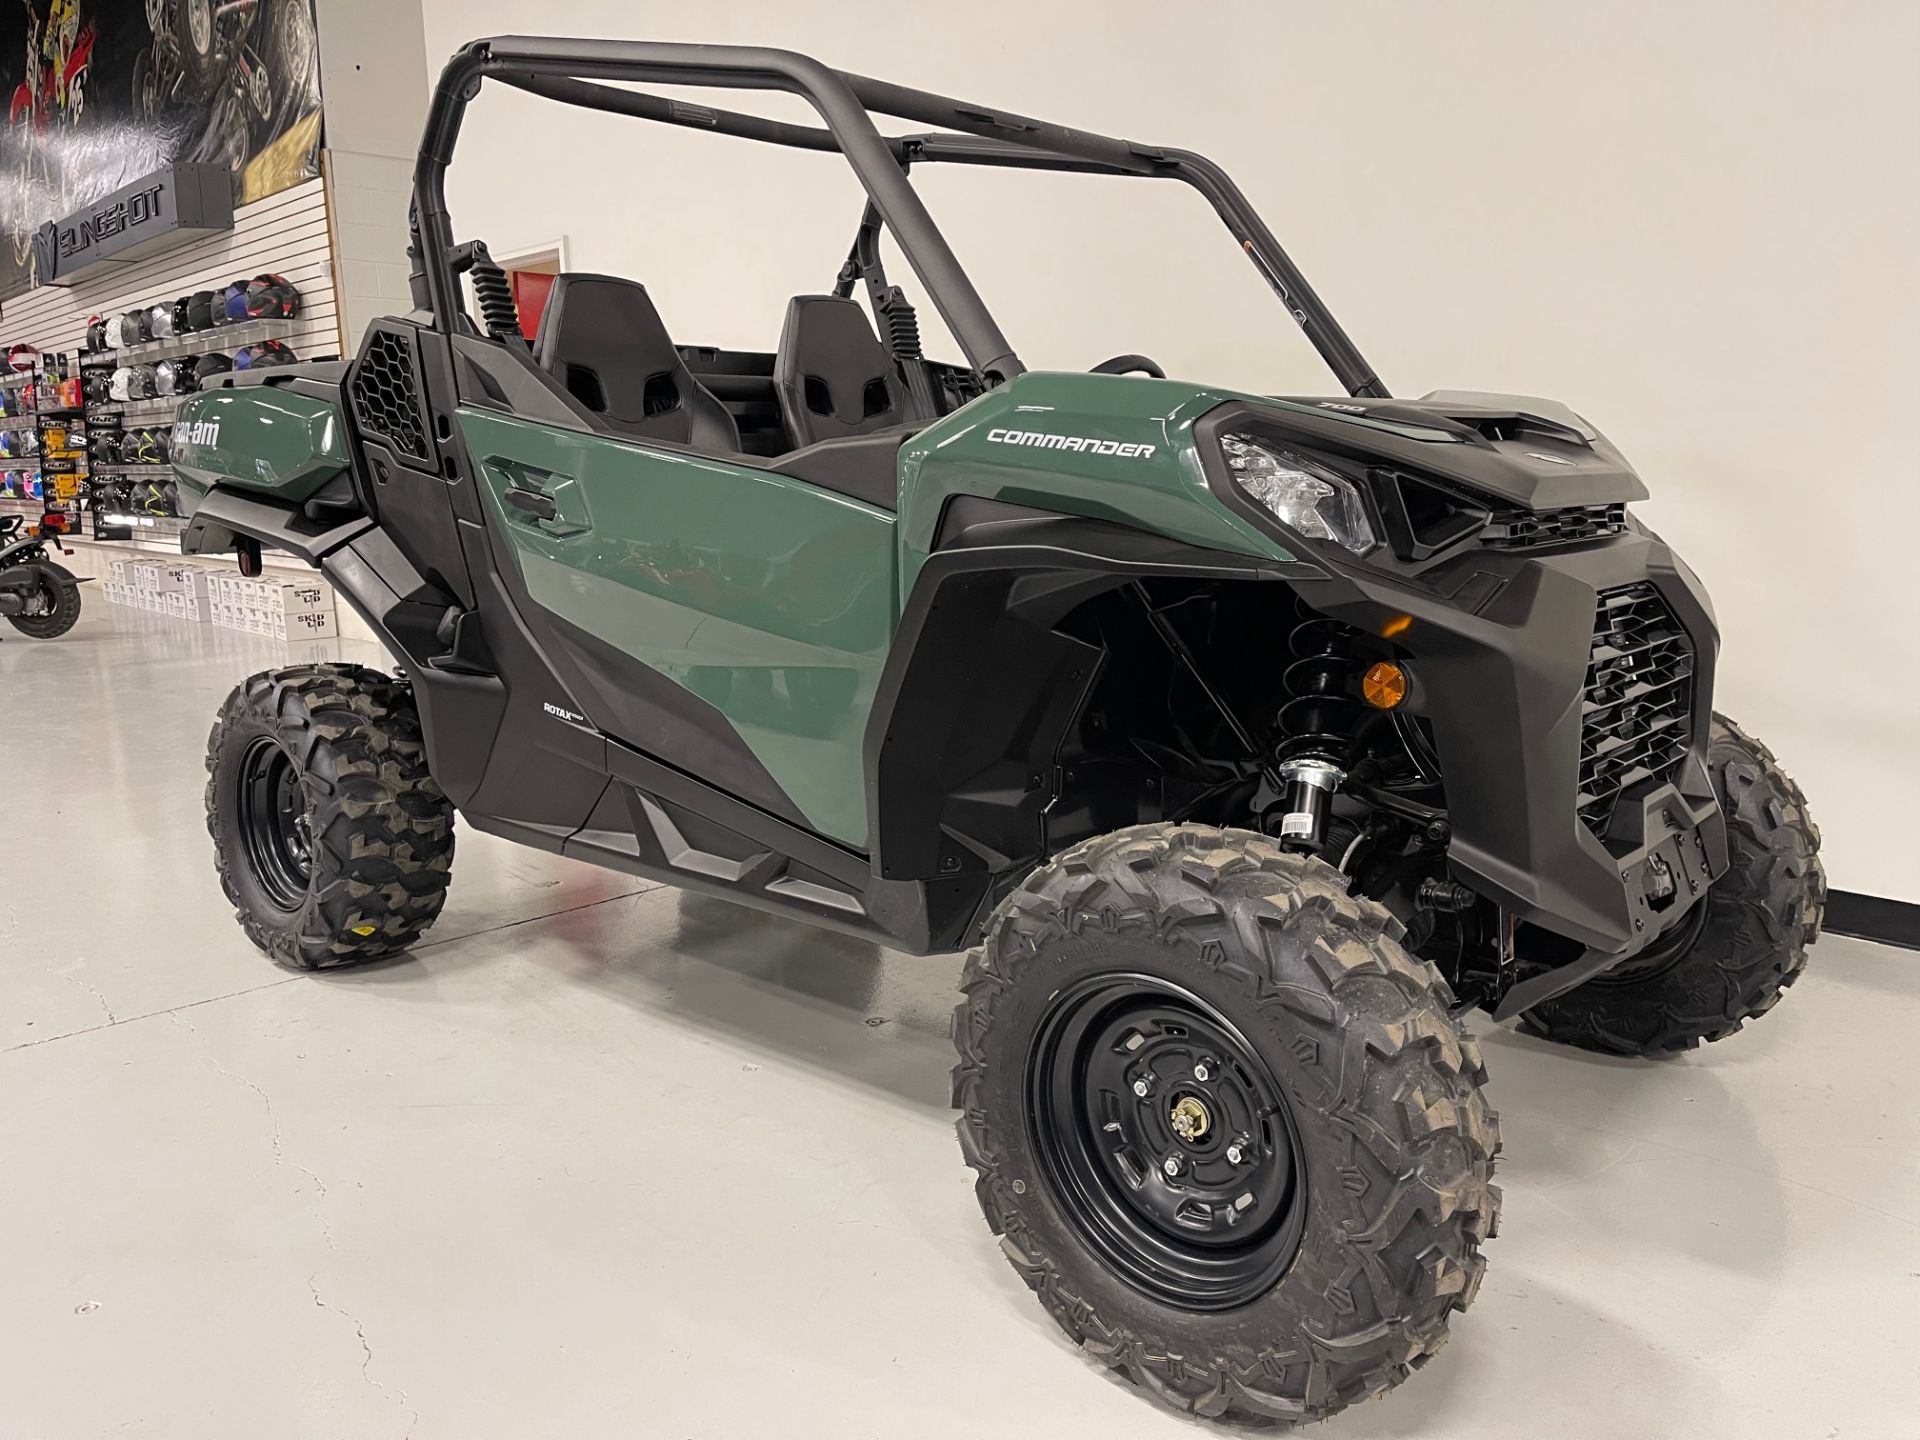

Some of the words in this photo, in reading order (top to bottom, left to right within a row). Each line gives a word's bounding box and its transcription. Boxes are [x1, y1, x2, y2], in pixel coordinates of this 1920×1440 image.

[60, 184, 163, 258] SLINGSHOT
[1317, 402, 1367, 412] 700
[987, 428, 1156, 458] COMMANDER
[543, 702, 571, 720] ROTAX
